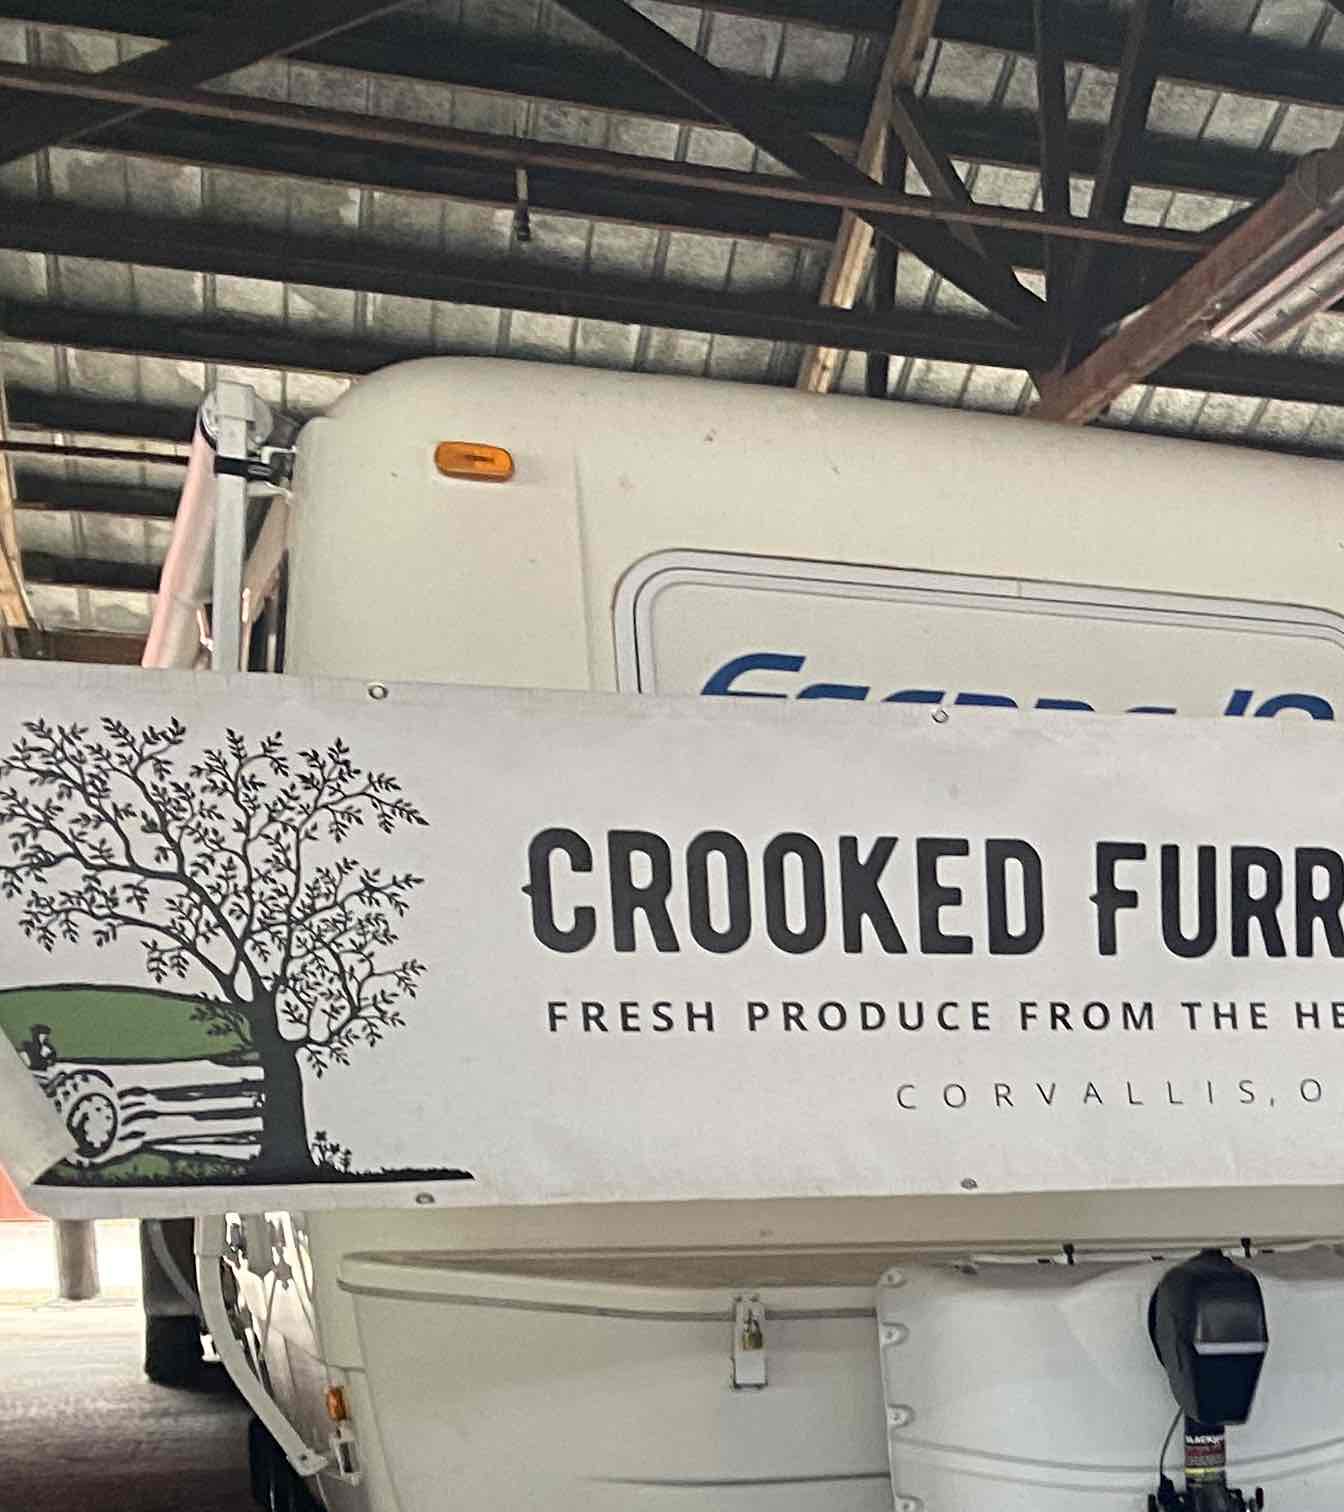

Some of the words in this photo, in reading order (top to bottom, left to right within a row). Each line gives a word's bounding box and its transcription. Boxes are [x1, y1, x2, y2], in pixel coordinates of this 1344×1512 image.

[521, 827, 1046, 956] CROOKED
[547, 1001, 715, 1032] FRESH
[748, 1001, 991, 1032] PRODUCE
[1020, 1001, 1154, 1031] FROM
[1181, 1001, 1269, 1030] THE
